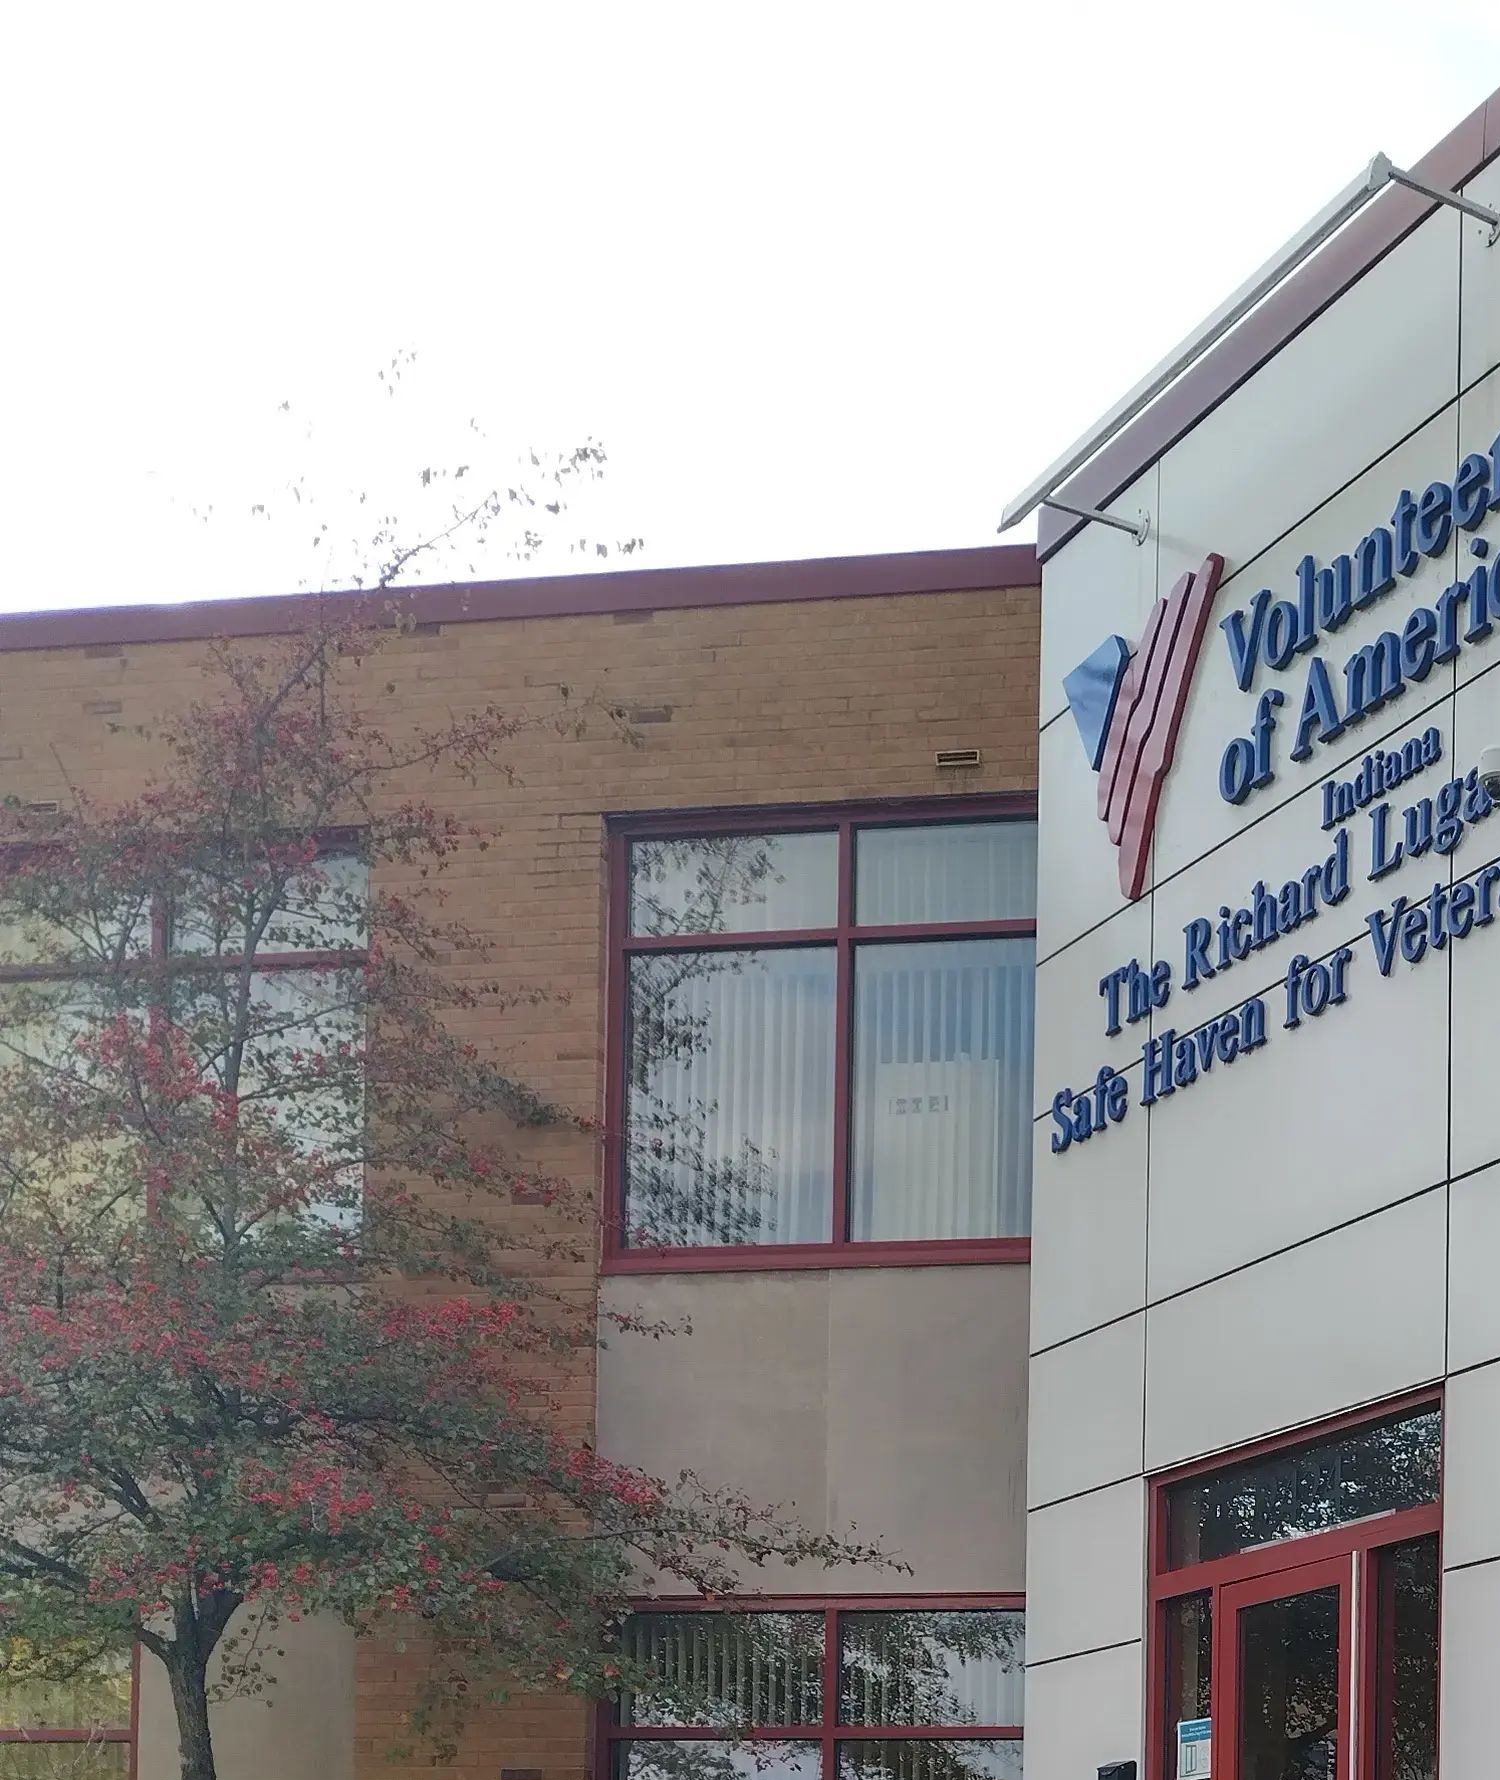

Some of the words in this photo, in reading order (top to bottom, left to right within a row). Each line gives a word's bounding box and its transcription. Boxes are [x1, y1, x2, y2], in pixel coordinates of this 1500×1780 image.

[1218, 688, 1286, 805] of
[1321, 725, 1443, 830] Indiana
[1099, 956, 1172, 1036] The
[1182, 826, 1350, 991] Richard
[1051, 1065, 1128, 1154] Safe
[1139, 997, 1269, 1107] Haven
[1283, 946, 1353, 1029] for
